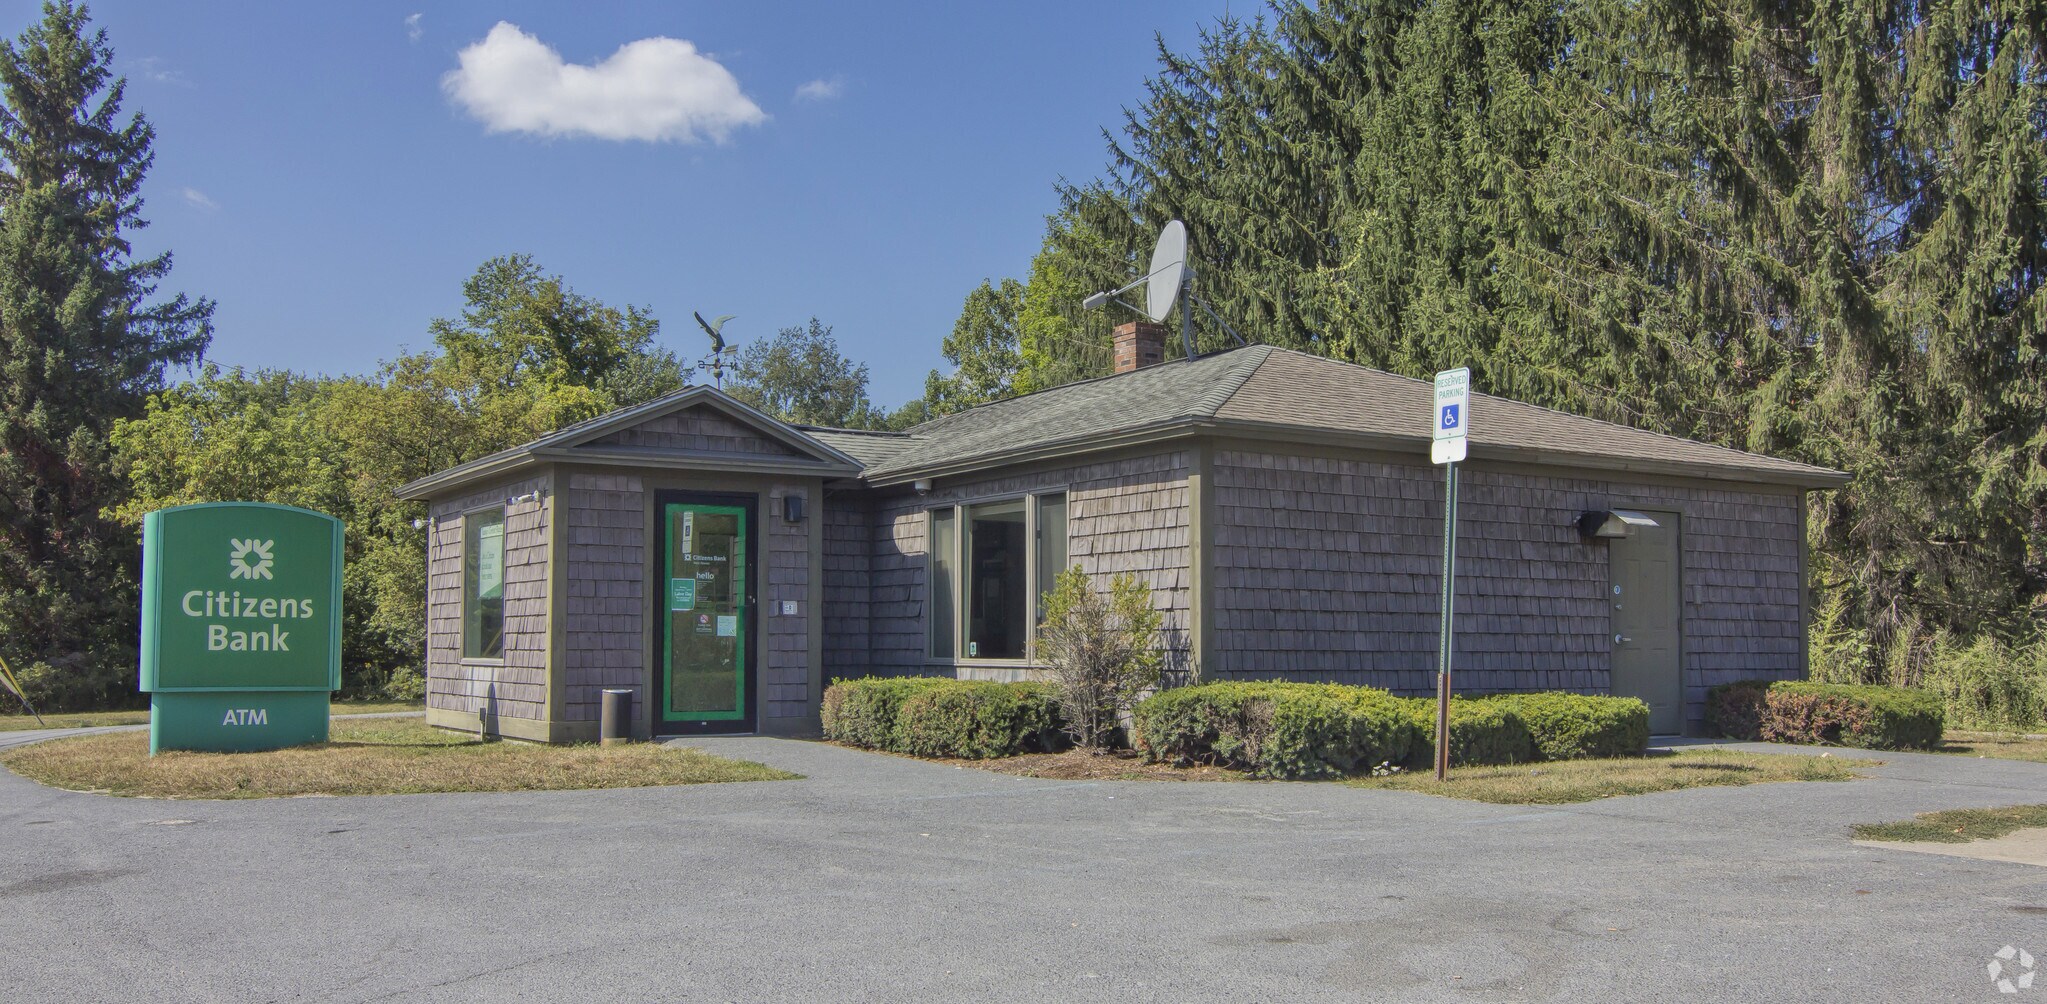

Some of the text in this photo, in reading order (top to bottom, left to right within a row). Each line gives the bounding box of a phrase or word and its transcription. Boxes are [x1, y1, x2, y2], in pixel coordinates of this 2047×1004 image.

[1438, 375, 1466, 388] RESERVED
[1439, 387, 1464, 399] PARKING
[696, 571, 714, 579] hello
[182, 590, 313, 618] Citizens
[208, 624, 289, 651] Bank
[222, 709, 268, 725] ATM
